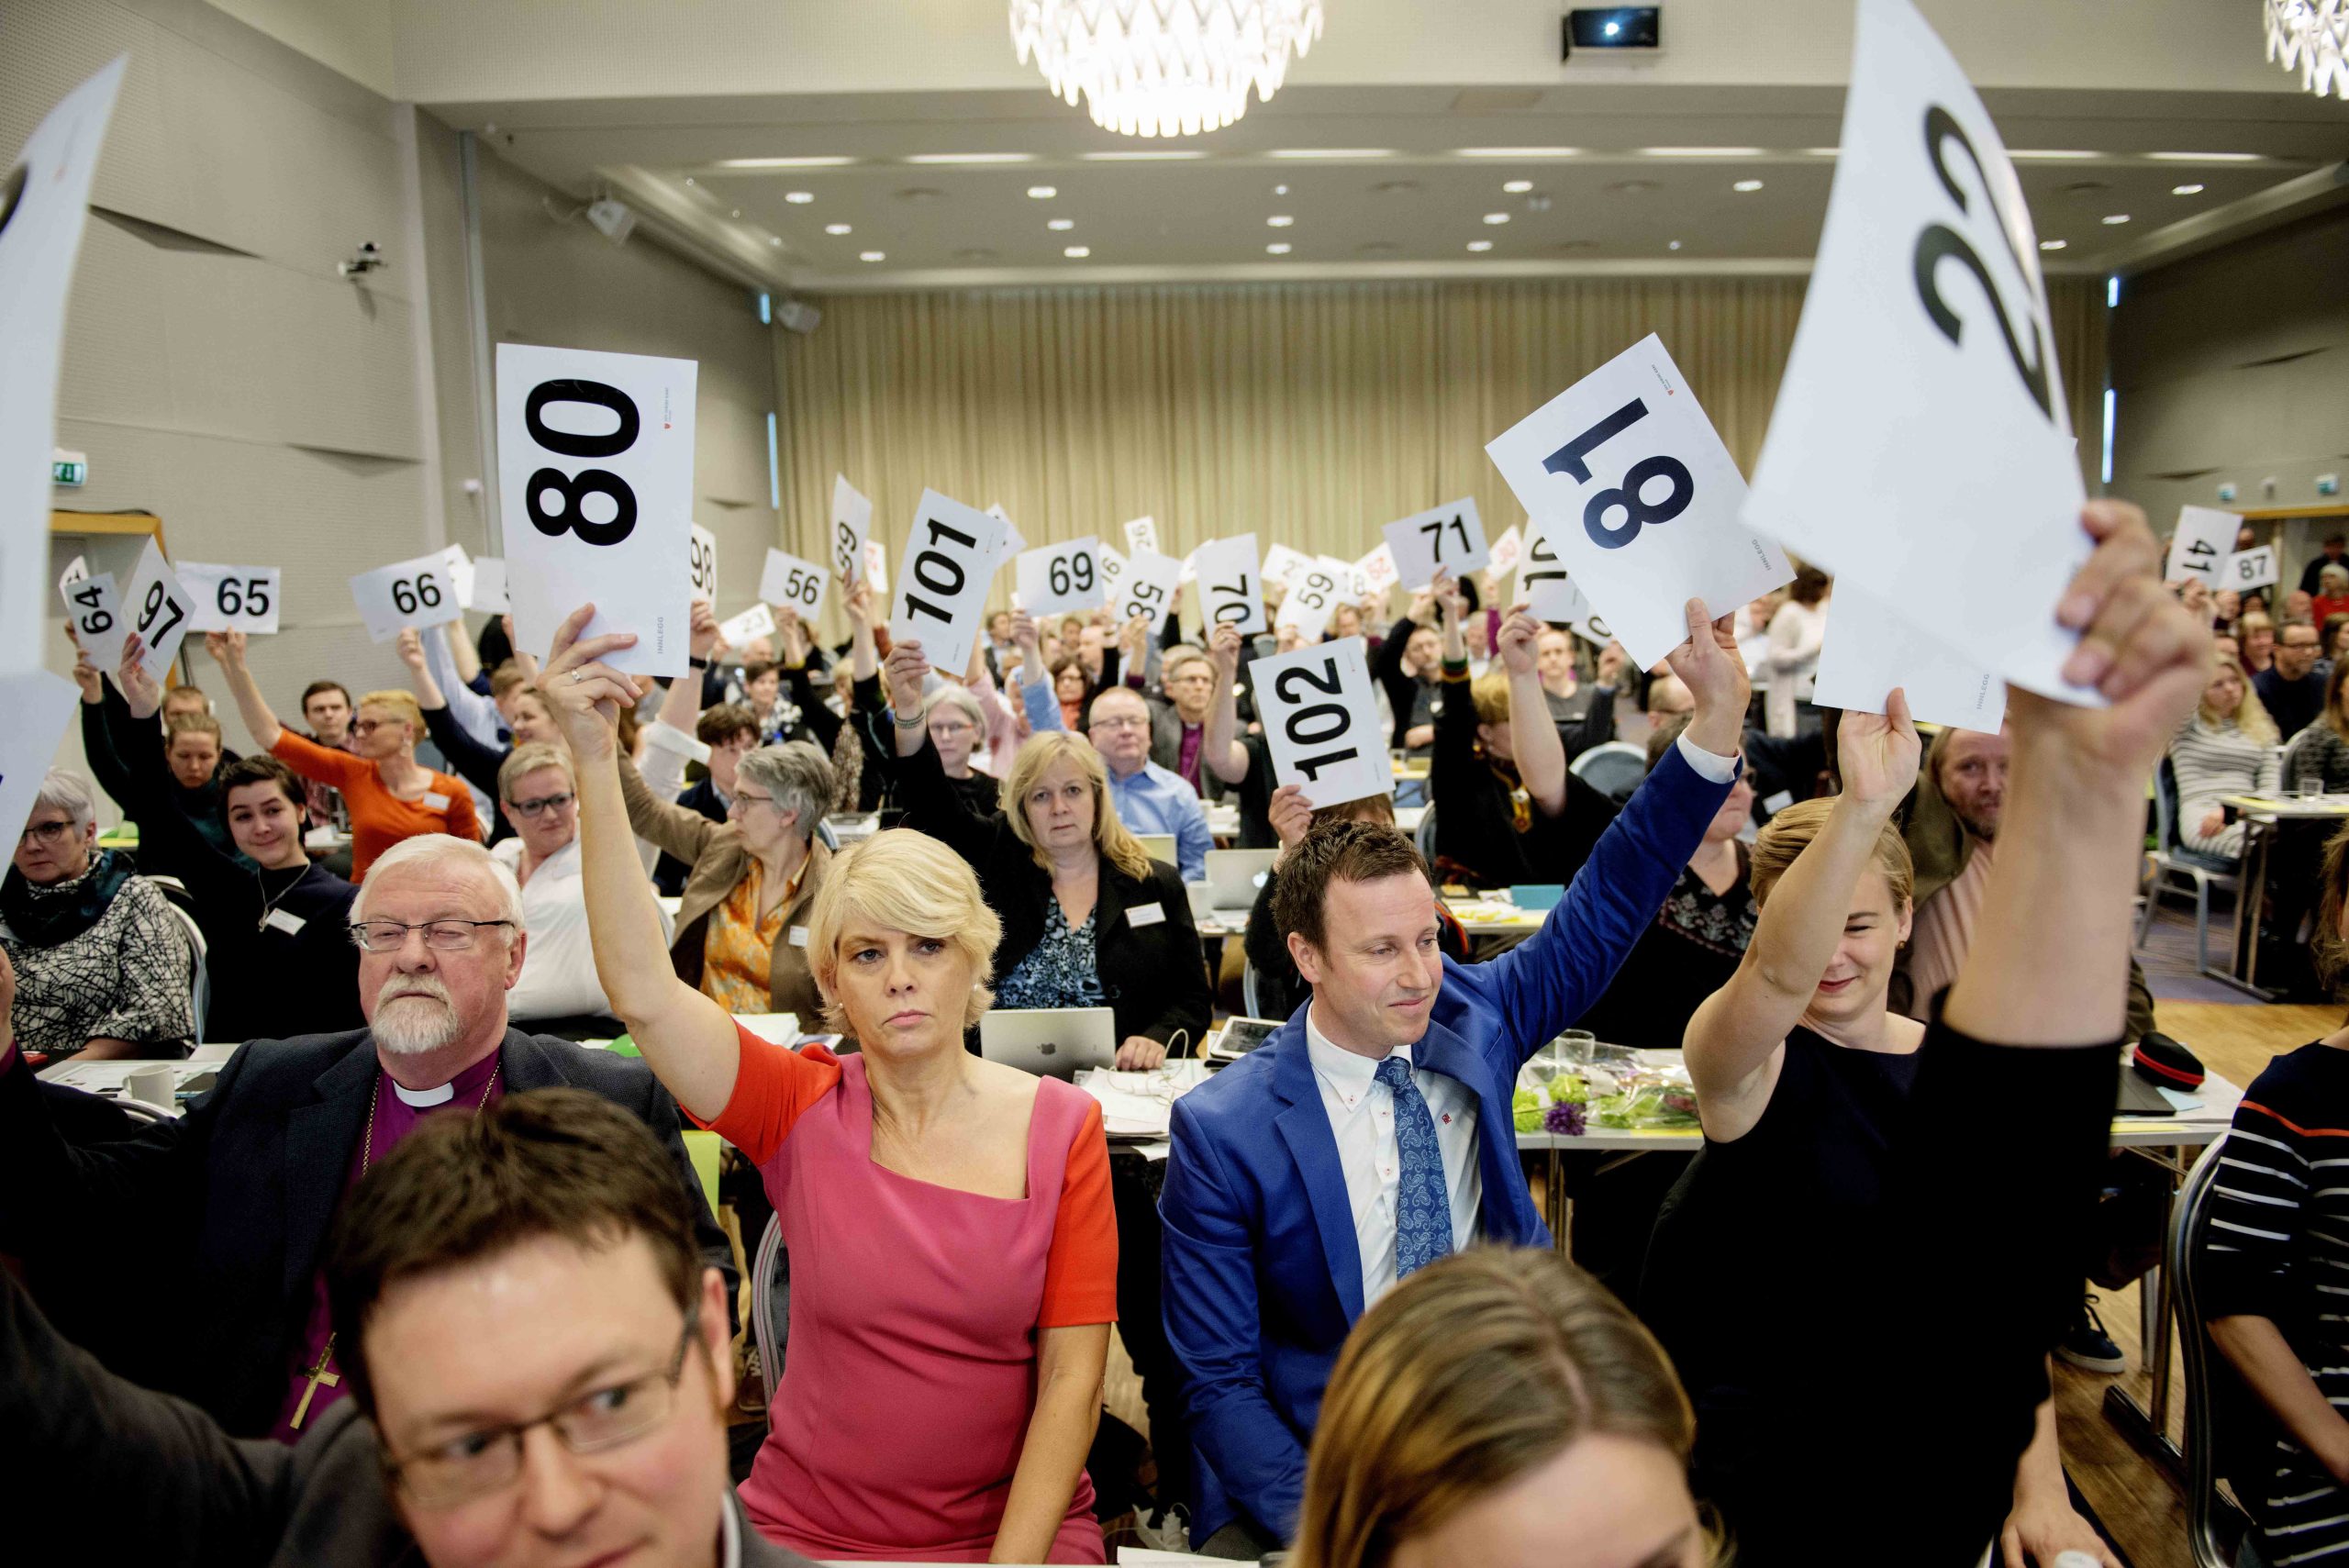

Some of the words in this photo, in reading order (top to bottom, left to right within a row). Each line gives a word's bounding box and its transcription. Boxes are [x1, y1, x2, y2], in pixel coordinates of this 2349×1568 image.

[525, 378, 640, 547] 80
[1541, 396, 1695, 550] 81
[1419, 513, 1472, 563] 71
[1752, 539, 1772, 571] INNLEGG
[2182, 539, 2217, 573] 41
[691, 536, 714, 596] 98
[785, 568, 820, 605] 56
[905, 517, 978, 625] 101
[1050, 550, 1094, 596] 69
[2238, 554, 2268, 580] 87
[73, 585, 113, 635] 64
[217, 577, 271, 617] 65
[391, 573, 441, 615] 66
[1127, 581, 1163, 622] 58
[1211, 573, 1251, 625] 70
[1297, 573, 1333, 610] 59
[138, 580, 184, 650] 97
[1976, 673, 1990, 710] INNLEGG
[1275, 657, 1359, 783] 102
